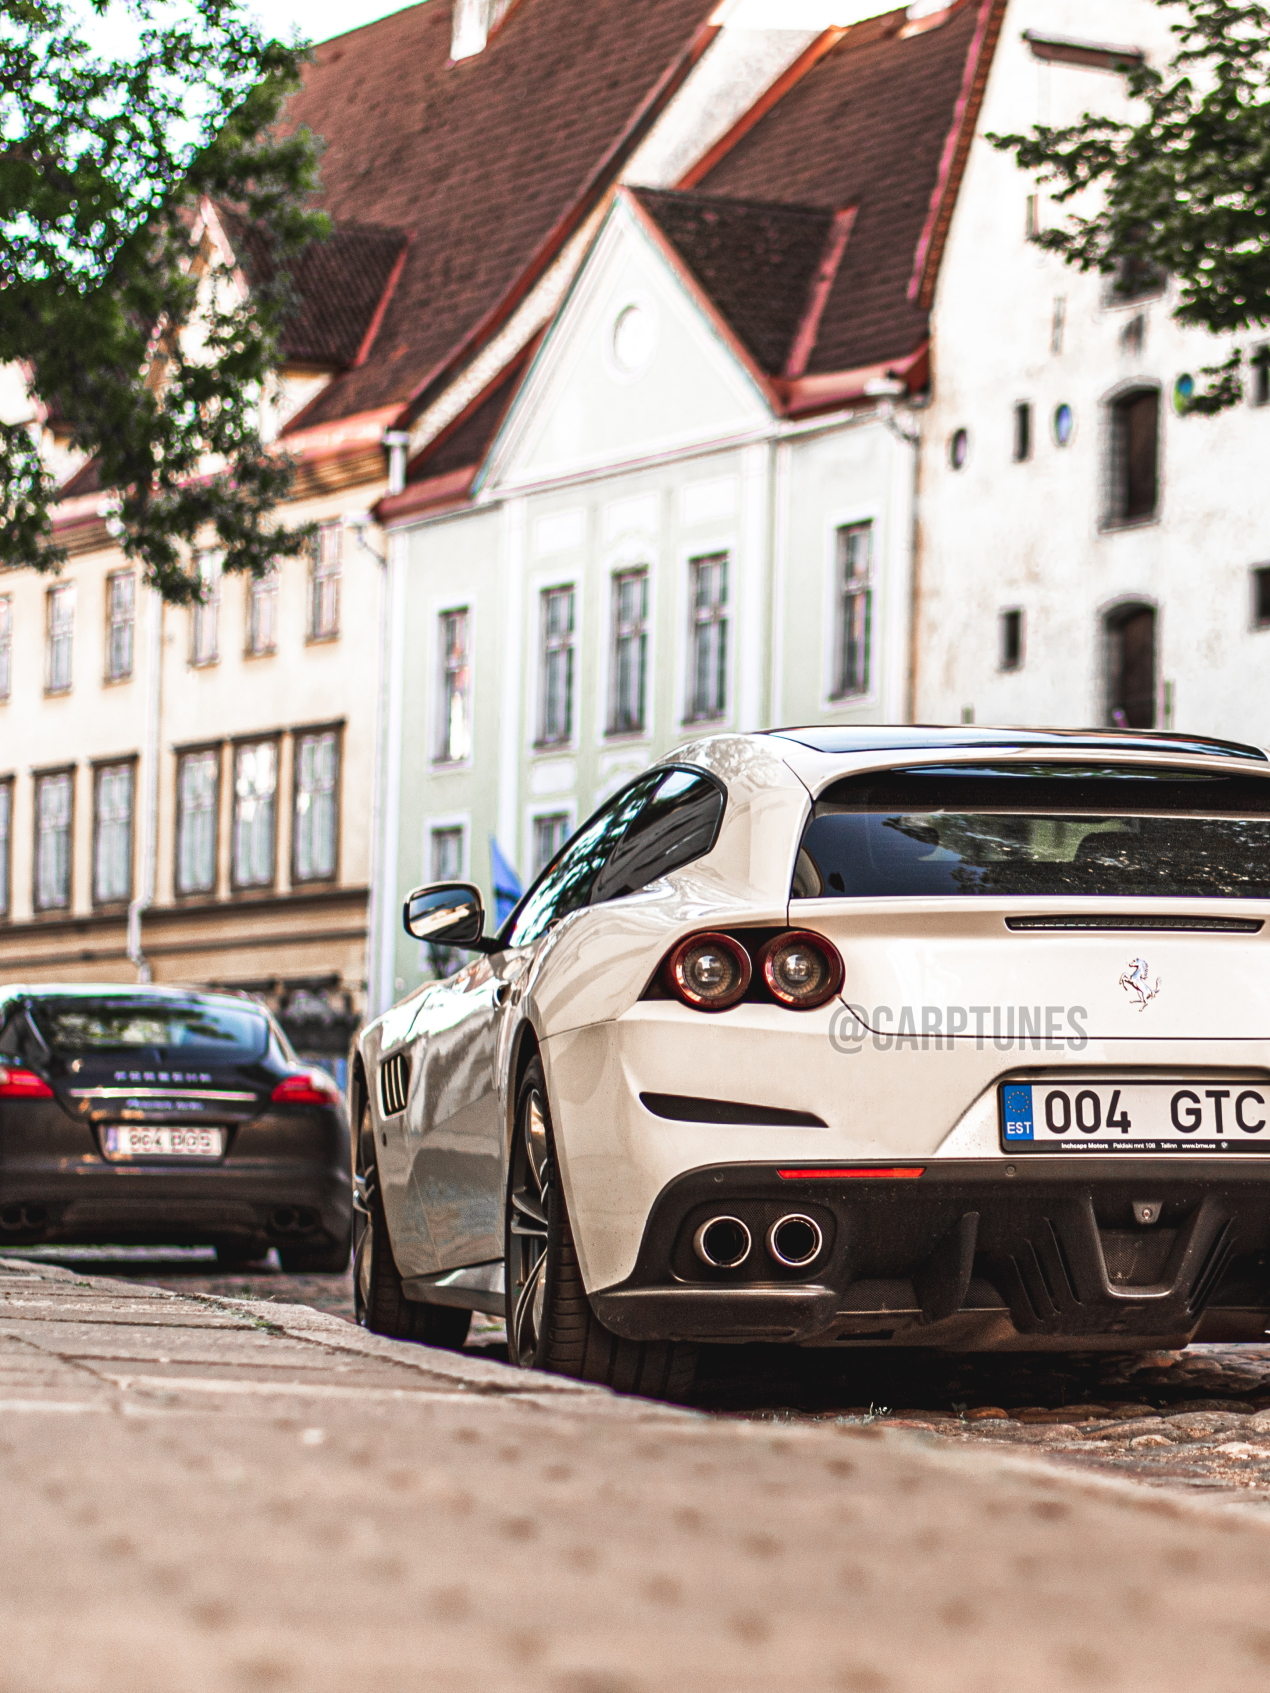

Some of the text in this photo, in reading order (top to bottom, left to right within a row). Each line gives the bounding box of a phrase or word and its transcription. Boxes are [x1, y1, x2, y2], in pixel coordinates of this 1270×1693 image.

[1045, 1089, 1266, 1134] 004 GTC
[1006, 1121, 1032, 1134] EST
[1061, 1142, 1087, 1150] Inchcape
